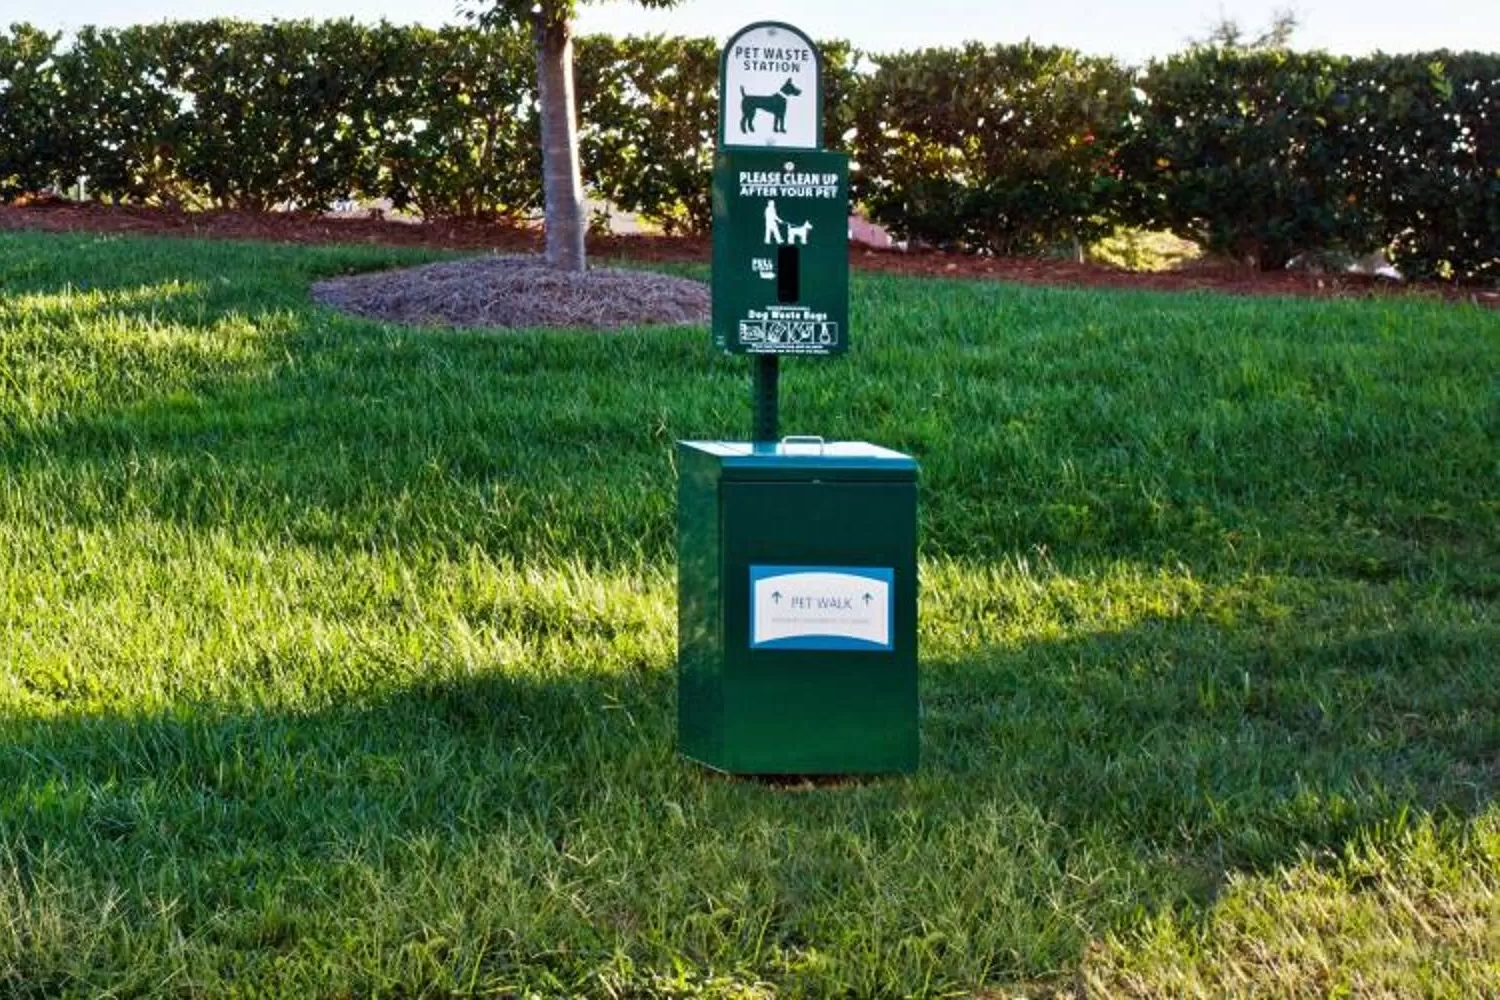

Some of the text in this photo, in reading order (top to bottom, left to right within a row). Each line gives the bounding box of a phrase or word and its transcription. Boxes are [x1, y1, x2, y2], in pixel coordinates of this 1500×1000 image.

[736, 46, 809, 61] PET WASTE
[743, 60, 801, 73] STATION
[739, 171, 839, 185] PLEASE CLEAN UP
[740, 186, 838, 198] AFTER YOUR PET
[748, 309, 769, 321] Dog
[791, 596, 853, 609] PET WALK
